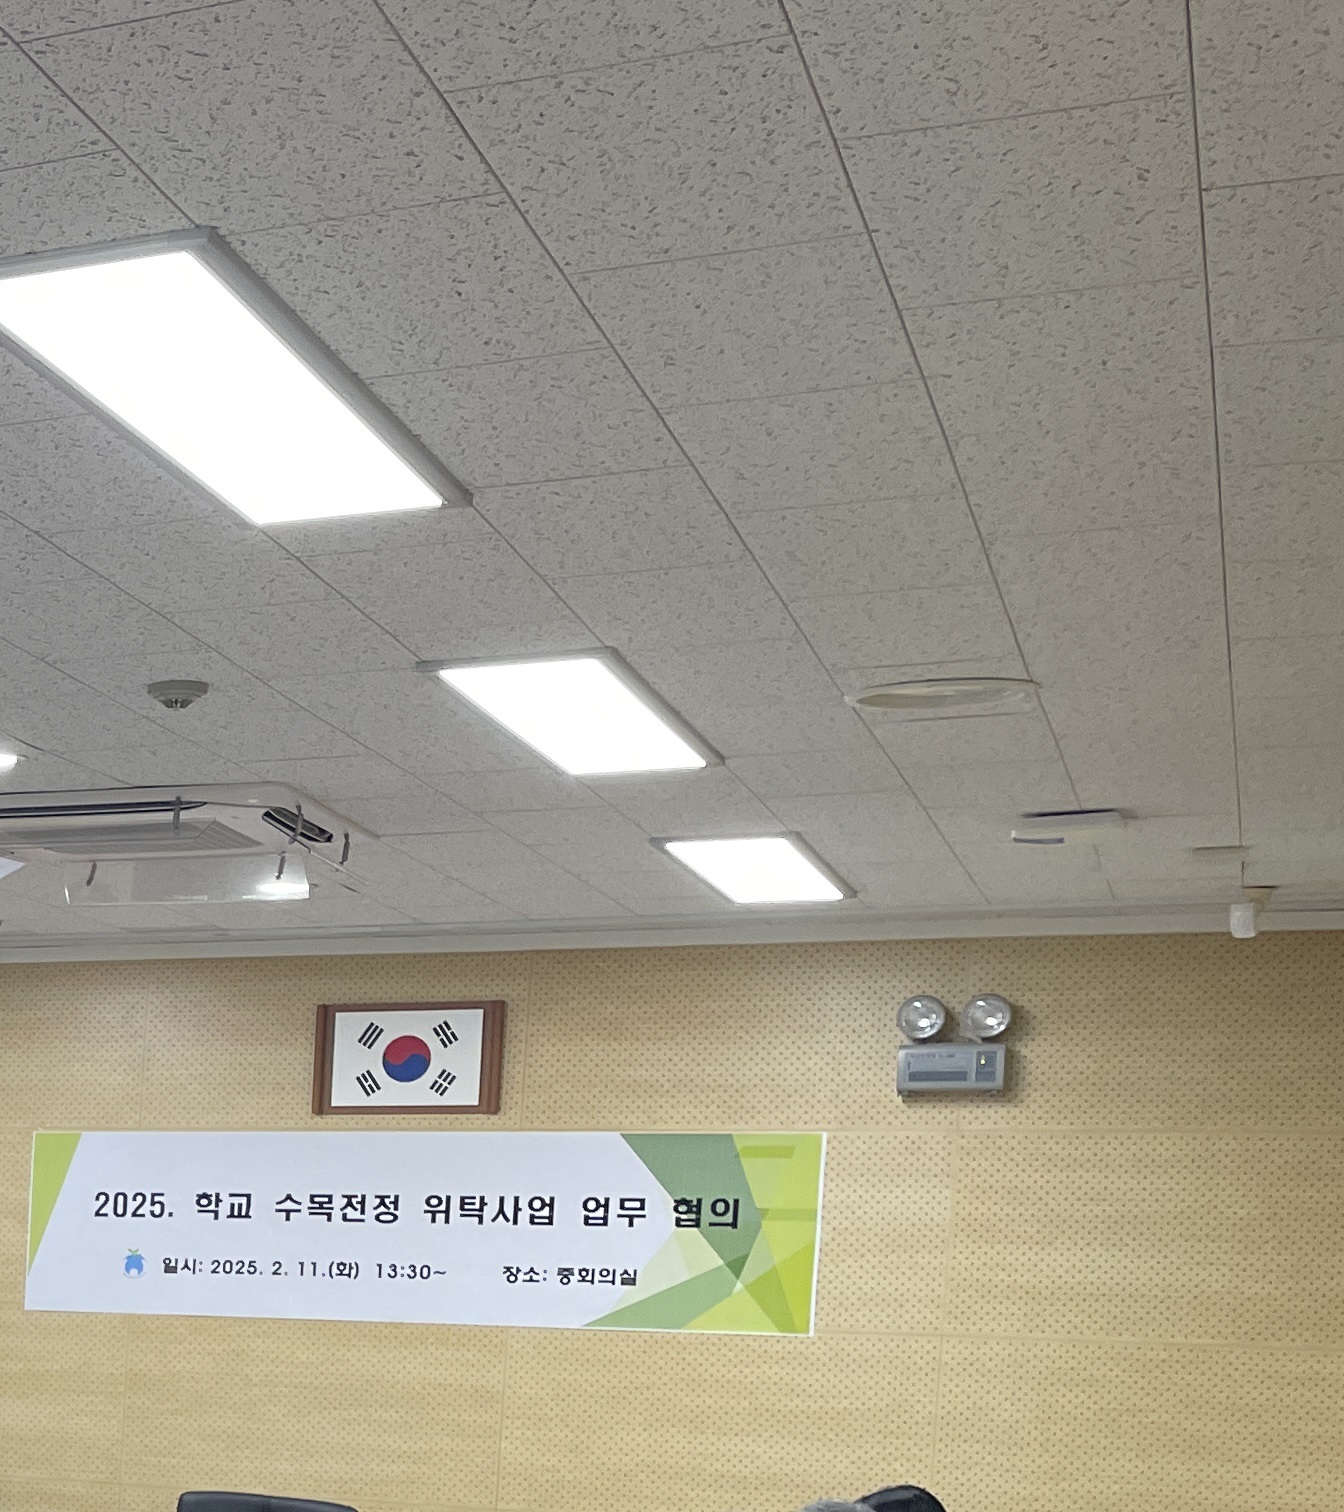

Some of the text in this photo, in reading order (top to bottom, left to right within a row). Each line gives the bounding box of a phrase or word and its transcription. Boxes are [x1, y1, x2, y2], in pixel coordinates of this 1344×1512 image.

[93, 1190, 740, 1230] 2025. 학교 수목전정 위탁사업 업무 협의
[161, 1256, 447, 1281] 일시: 2025. 2. 11.(화) 13:30~
[502, 1265, 638, 1287] 장소: 중회의실
